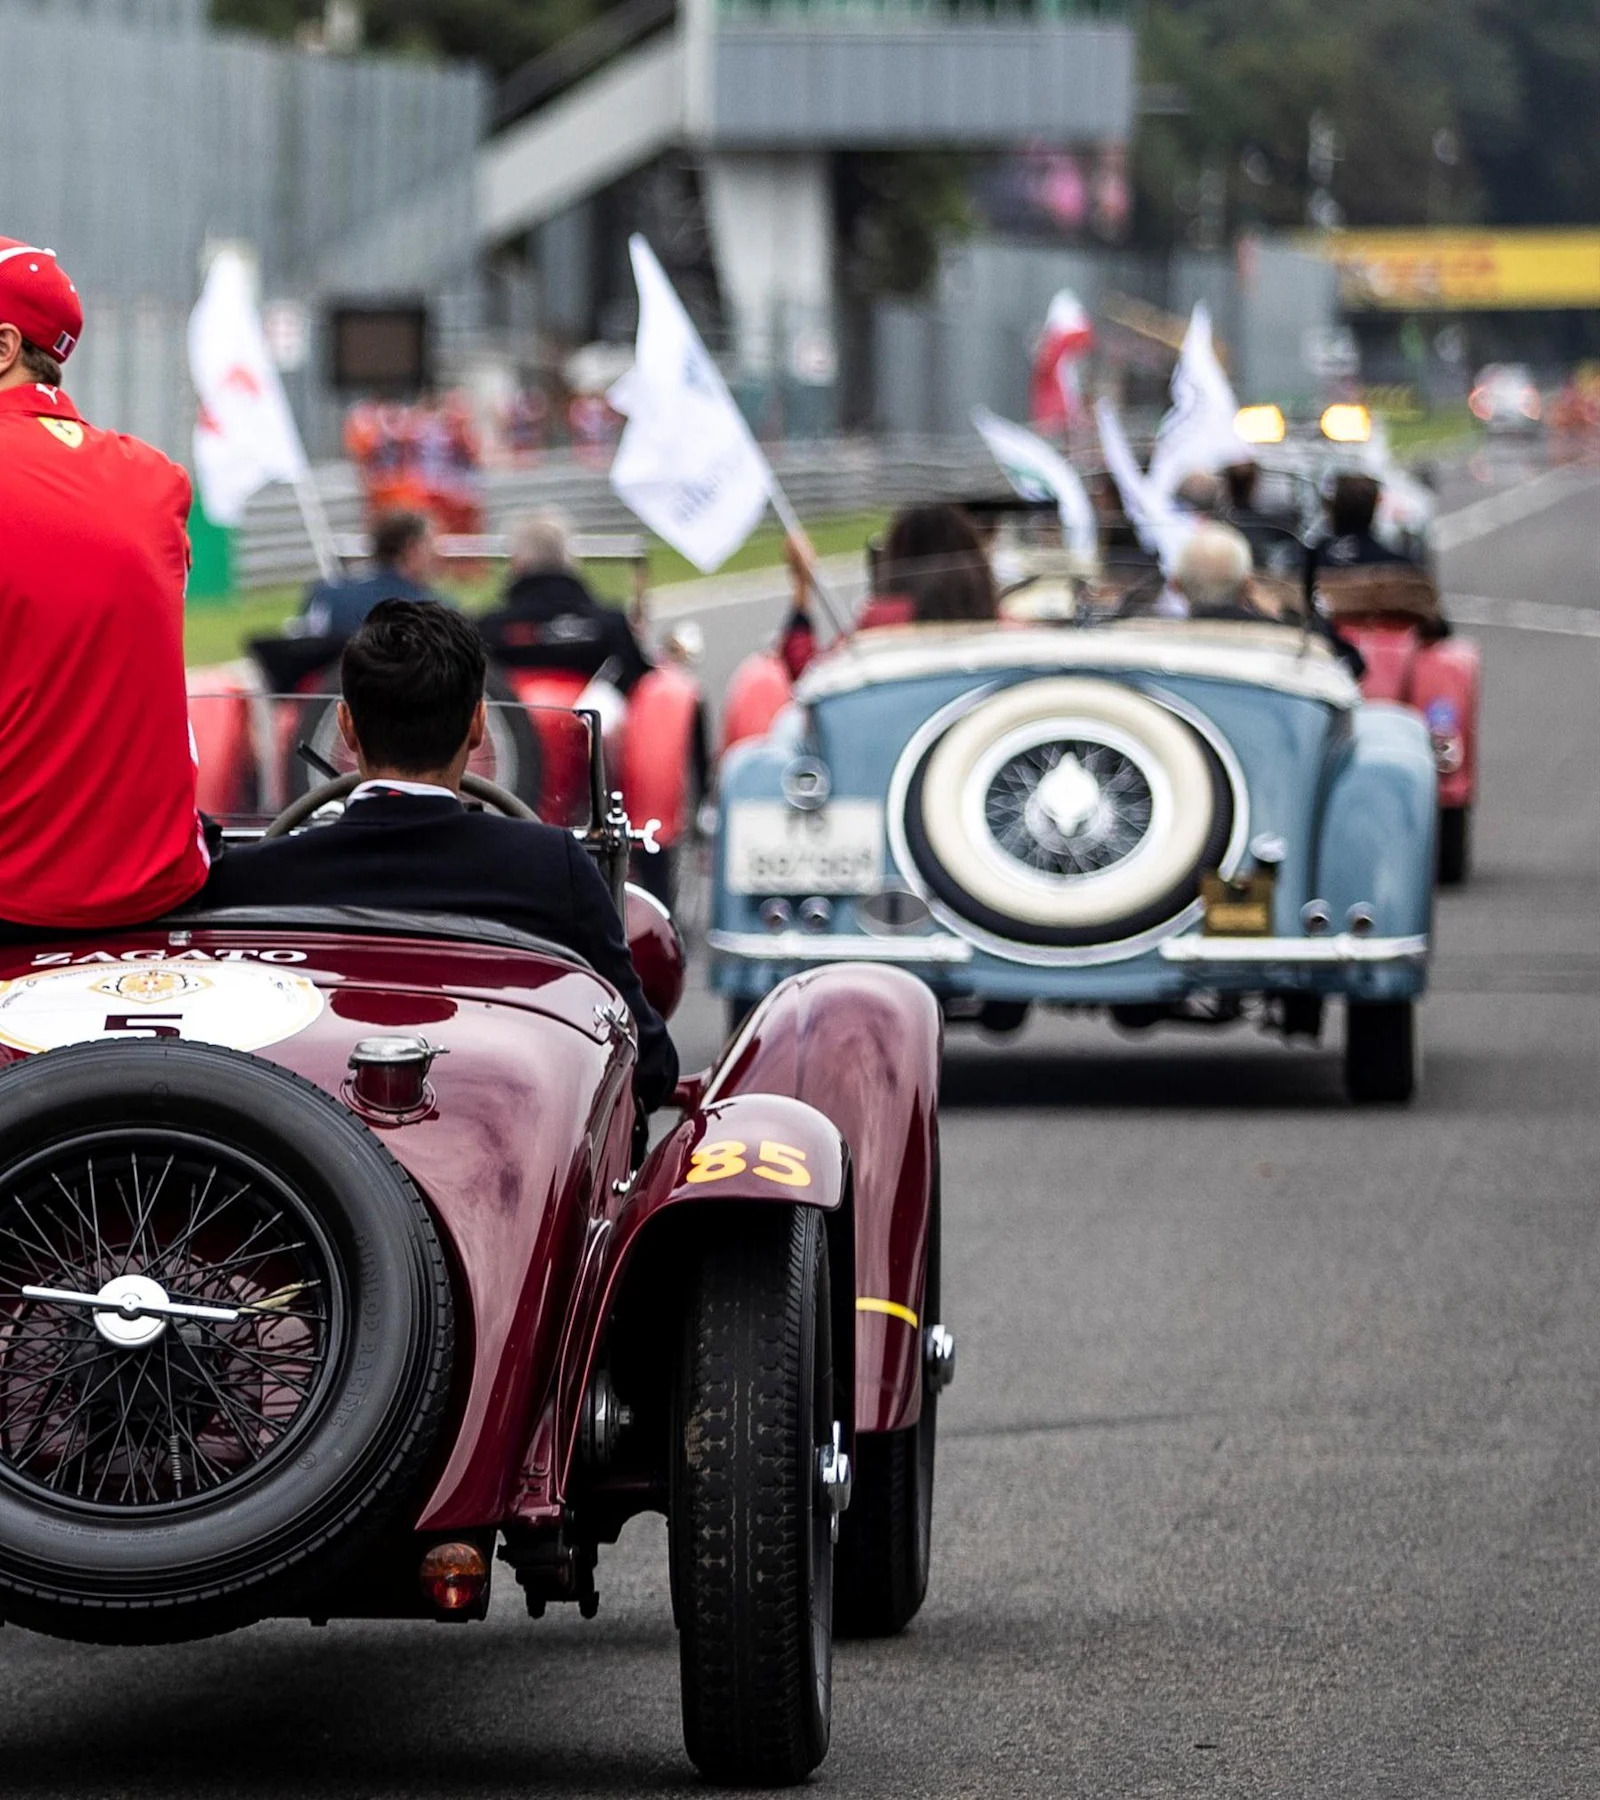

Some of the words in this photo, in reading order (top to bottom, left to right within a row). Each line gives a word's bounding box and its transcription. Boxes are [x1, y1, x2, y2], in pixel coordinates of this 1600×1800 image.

[31, 949, 308, 966] ZAGATO
[104, 1014, 183, 1038] 5
[686, 1140, 811, 1187] 85
[354, 1232, 381, 1333] DUNLOP
